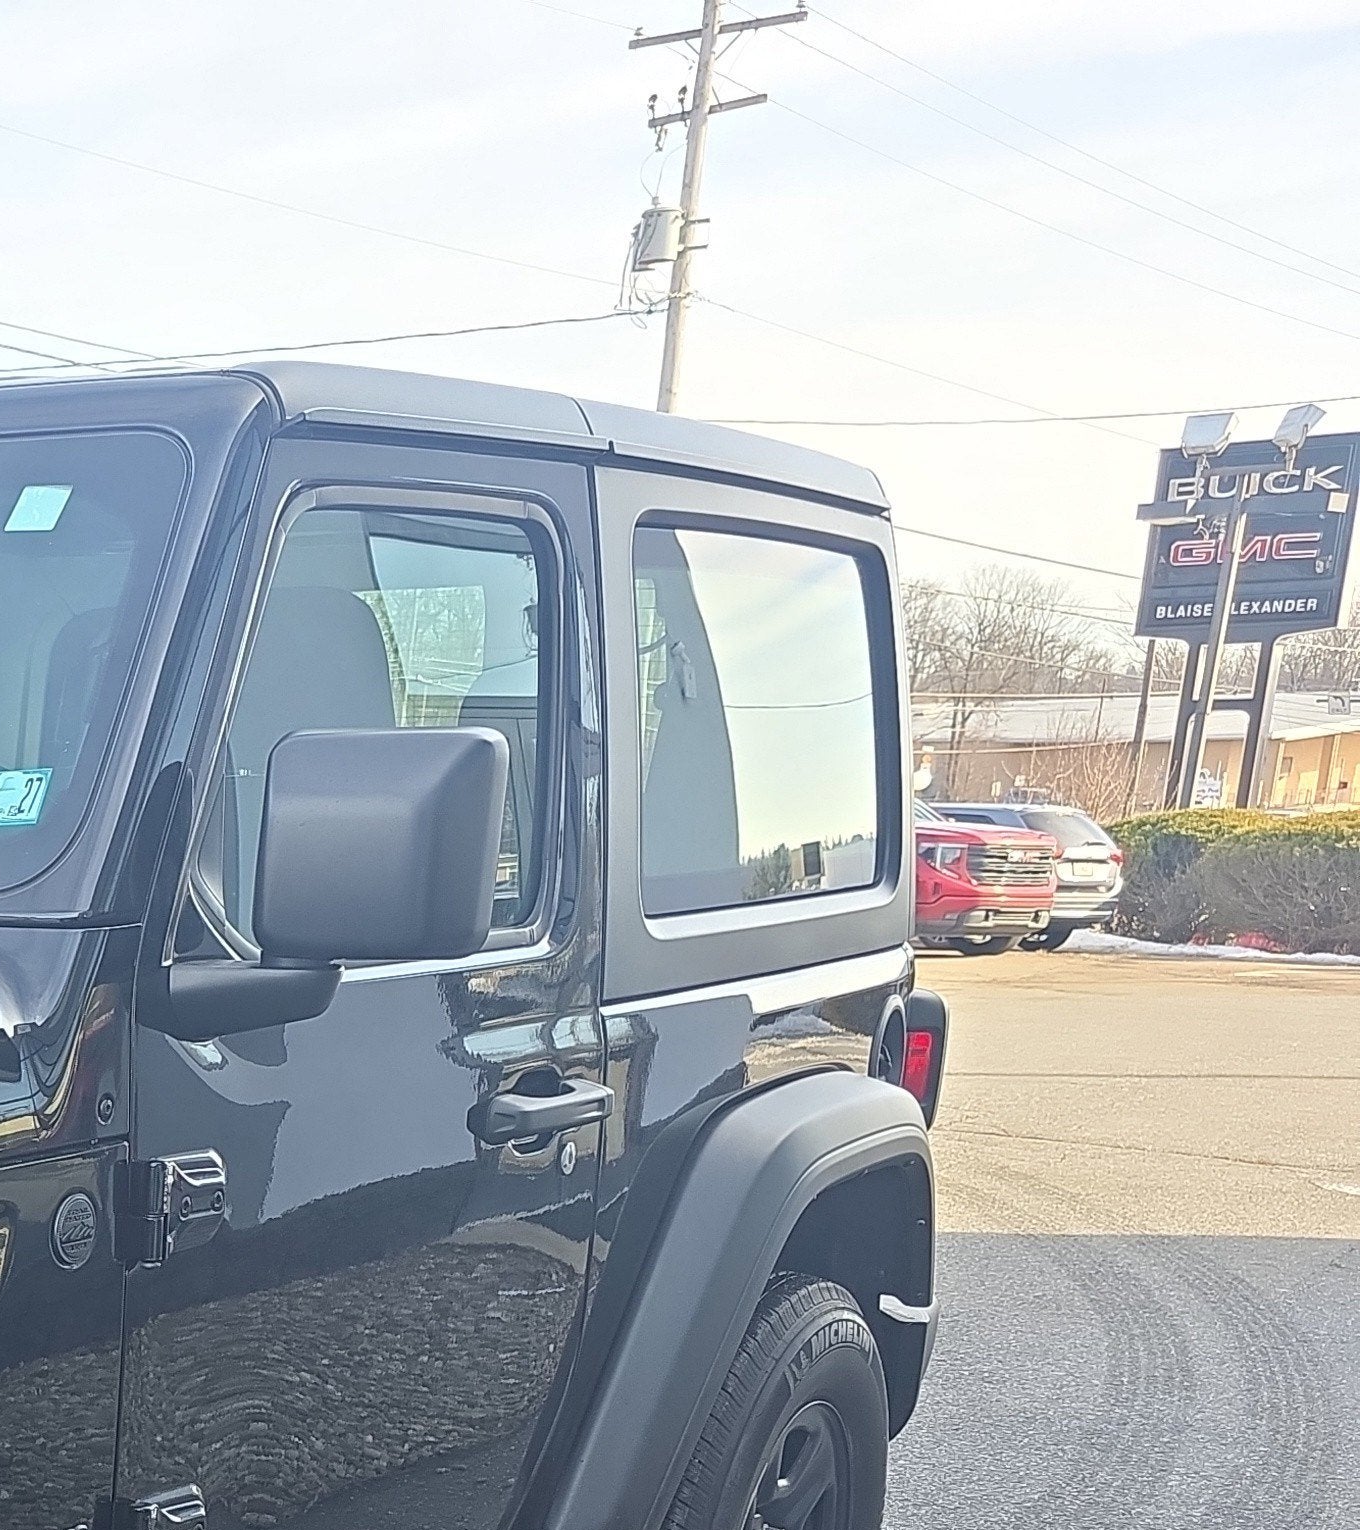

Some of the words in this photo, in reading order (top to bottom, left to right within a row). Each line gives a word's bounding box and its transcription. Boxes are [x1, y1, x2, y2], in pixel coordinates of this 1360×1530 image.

[1167, 465, 1344, 502] BUICK
[1170, 532, 1321, 566] GMC
[1156, 602, 1214, 619] BLAISE
[1231, 598, 1318, 615] LEXANDER
[17, 776, 44, 814] 27
[811, 1320, 871, 1361] MICHELIN
